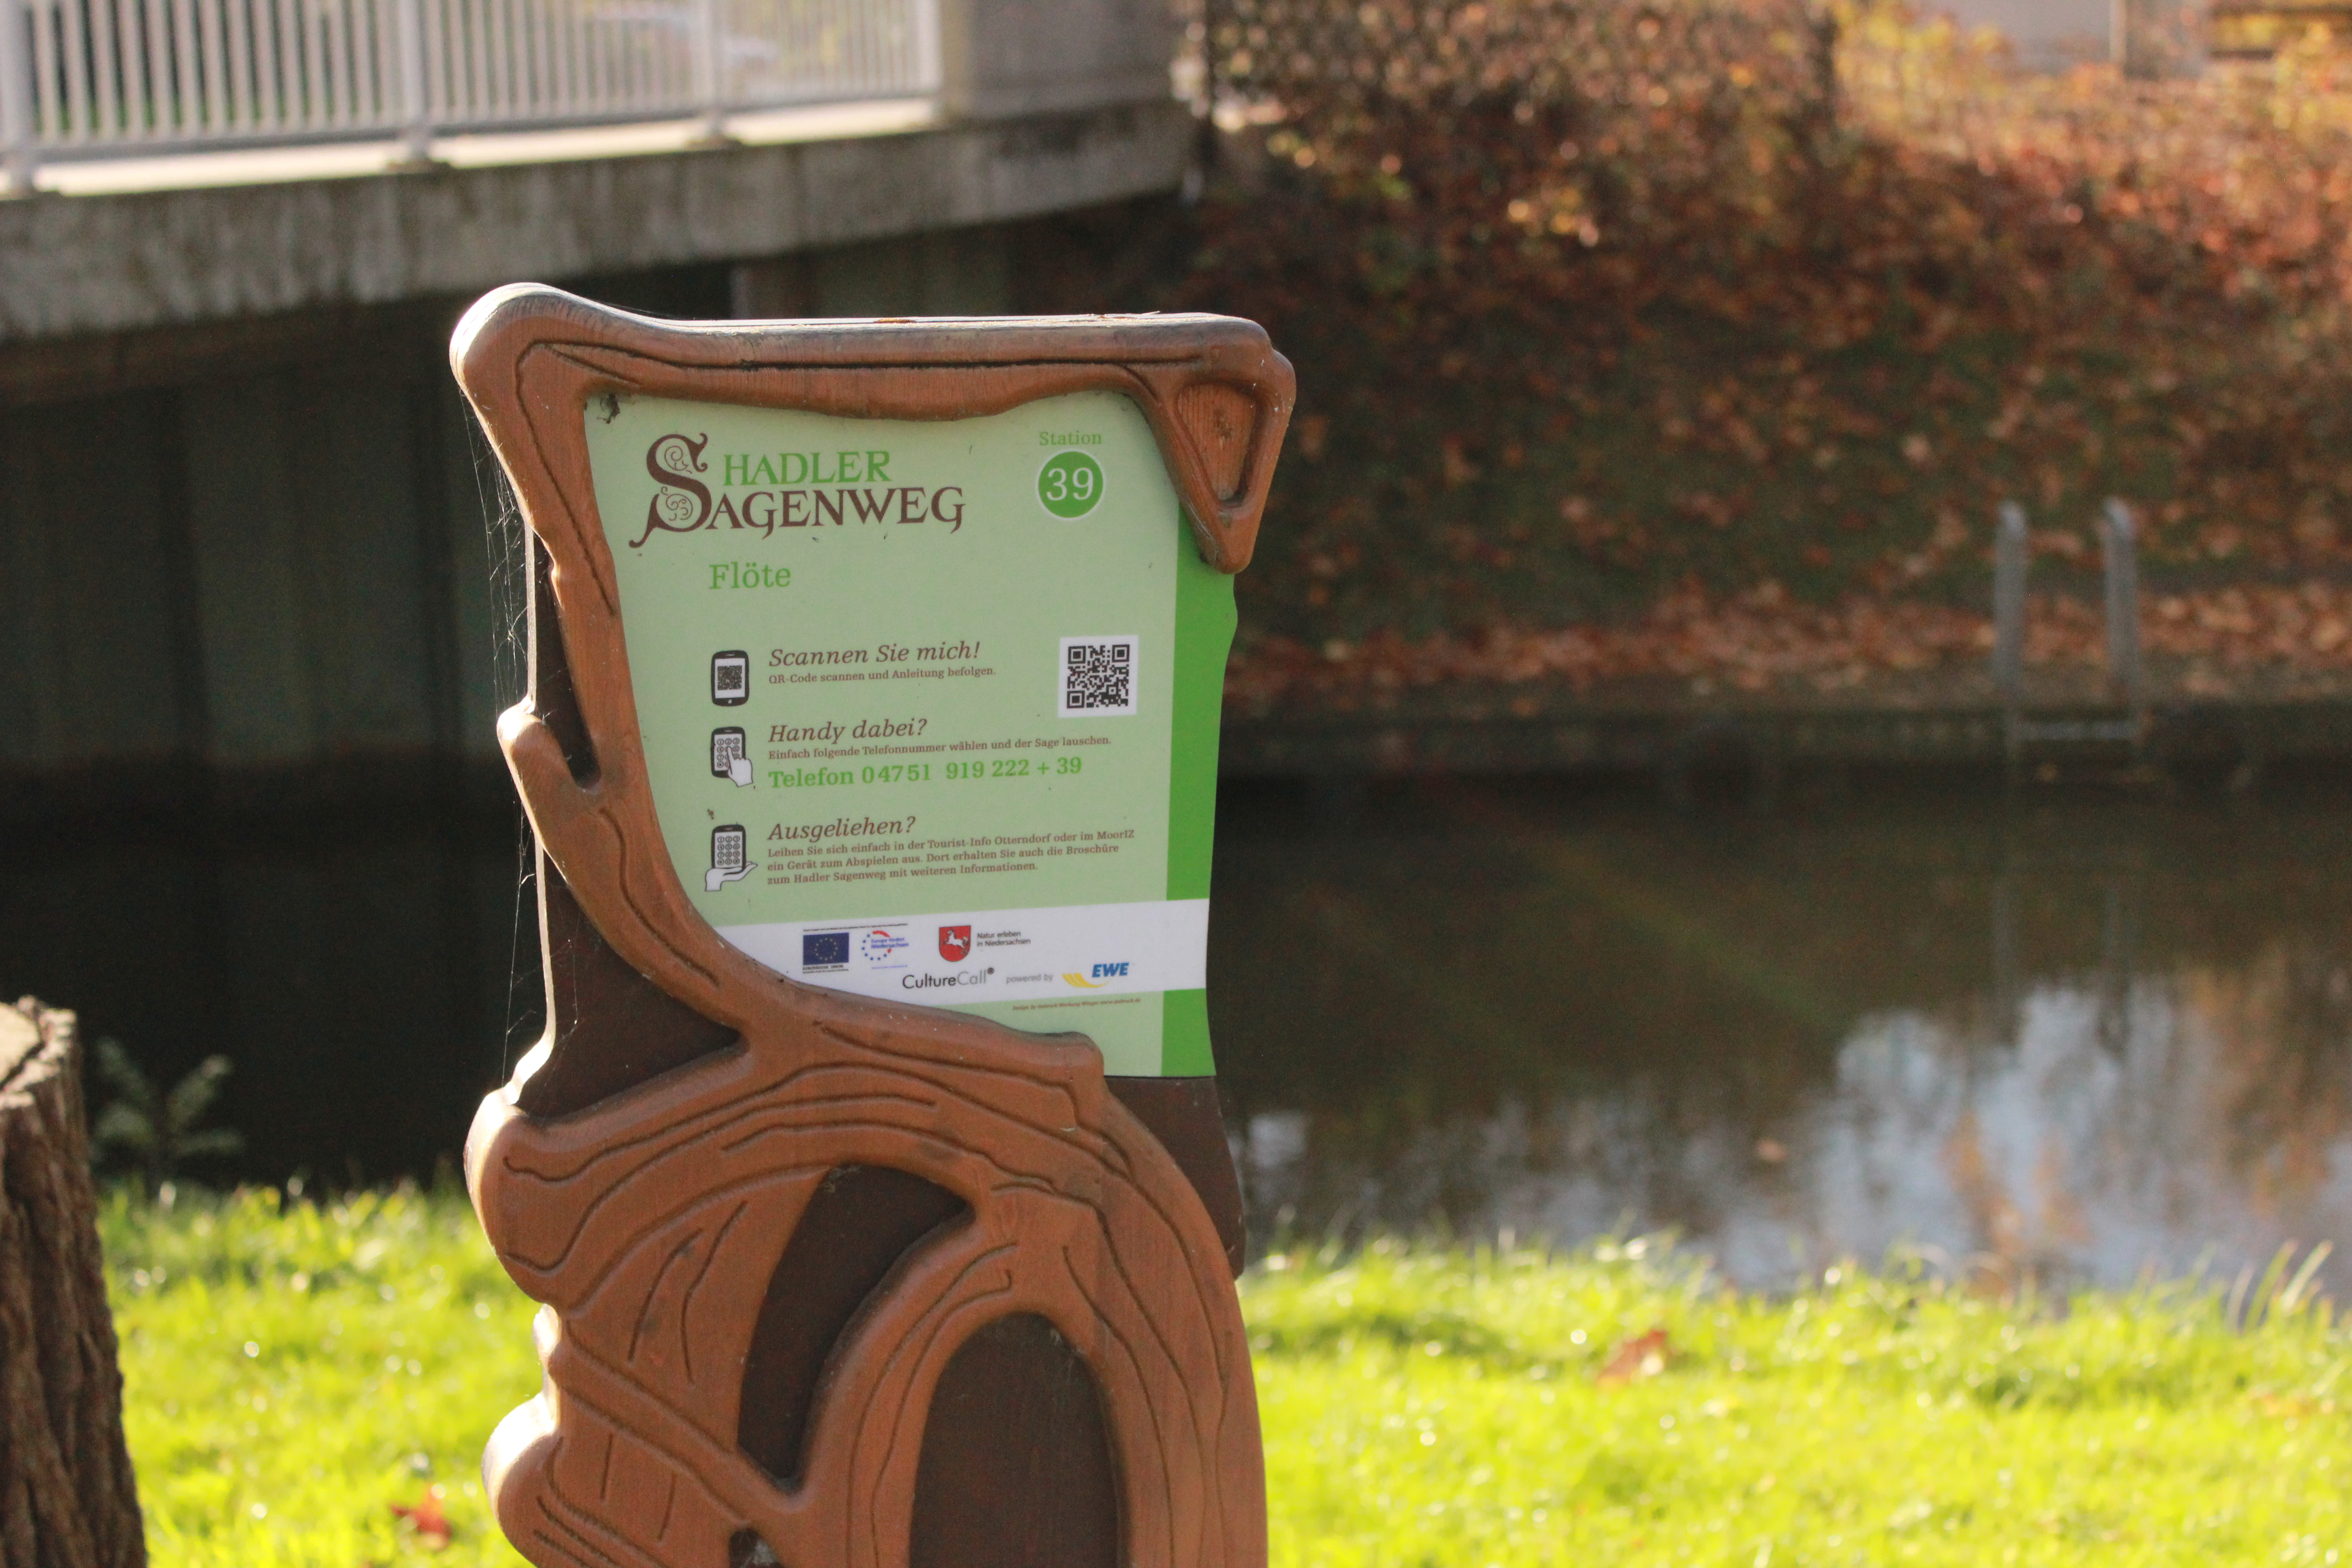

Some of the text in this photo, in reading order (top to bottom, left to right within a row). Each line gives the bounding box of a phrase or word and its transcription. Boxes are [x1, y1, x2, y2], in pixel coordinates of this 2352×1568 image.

[1037, 430, 1101, 448] Station
[724, 451, 891, 485] HADLER
[629, 433, 965, 548] SAGENWEG
[1045, 467, 1094, 500] 39
[709, 562, 790, 589] Flöte
[769, 641, 980, 666] Scannen Sie mich!
[769, 673, 817, 684] QR-Code
[869, 670, 888, 679] und
[892, 669, 944, 679] Anleitung
[948, 666, 996, 677] befolgen.
[769, 718, 927, 744] Handy dabei?
[769, 736, 1111, 759] Einfach folgende Telefonnummer wählen und der Sage lauschen.
[769, 757, 1082, 788] Telefon 04751 919 222 + 39
[767, 816, 916, 844] Ausgeliehen?
[769, 848, 803, 857] Leihen
[807, 846, 823, 855] Sie
[827, 844, 848, 854] sich
[852, 842, 890, 852] einfach
[895, 842, 904, 850] in
[908, 841, 925, 849] der
[927, 837, 991, 848] Tourist-Info
[995, 833, 1051, 844] Otterndorf
[1054, 833, 1077, 842] oder
[1081, 832, 1093, 840] im
[768, 862, 784, 871] ein
[787, 860, 817, 869] Gerät
[846, 855, 898, 867] Abspielen
[953, 851, 996, 860] erhalten
[1000, 849, 1015, 858] Sie
[1019, 848, 1043, 857] auch
[1047, 847, 1063, 855] die
[1067, 844, 1118, 854] Broschüre
[794, 873, 830, 882] Hadler
[834, 872, 886, 882] Sagenweg
[890, 868, 907, 877] mit
[911, 867, 956, 876] weiteren
[960, 862, 1038, 873] Informationen.
[1006, 974, 1053, 984] powered by
[1092, 962, 1130, 978] EWE
